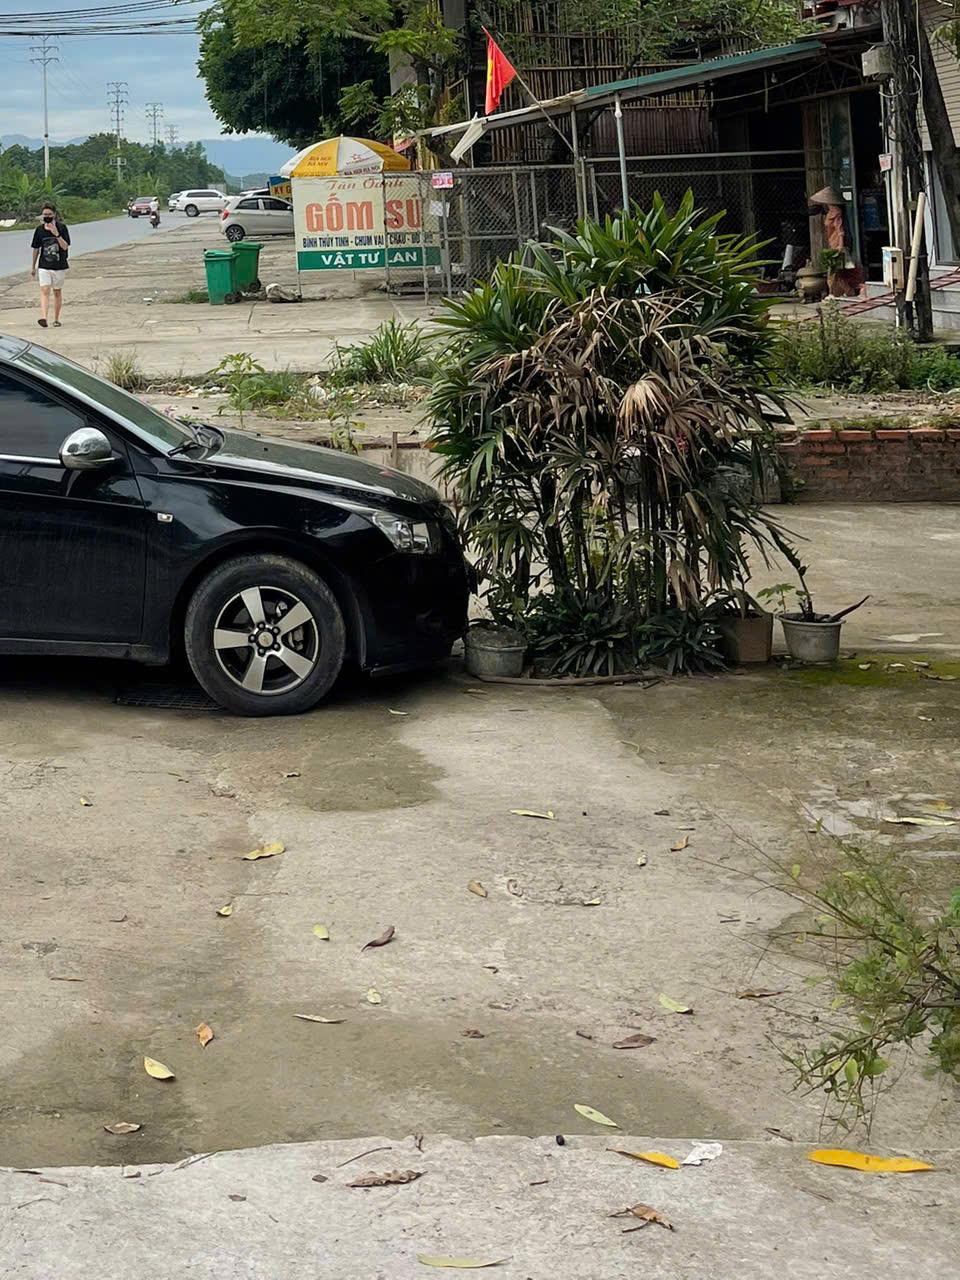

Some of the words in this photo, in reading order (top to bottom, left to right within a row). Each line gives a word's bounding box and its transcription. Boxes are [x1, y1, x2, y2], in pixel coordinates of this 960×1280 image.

[305, 193, 374, 232] GỐM
[321, 252, 354, 268] VẬT
[359, 252, 380, 264] TƯ
